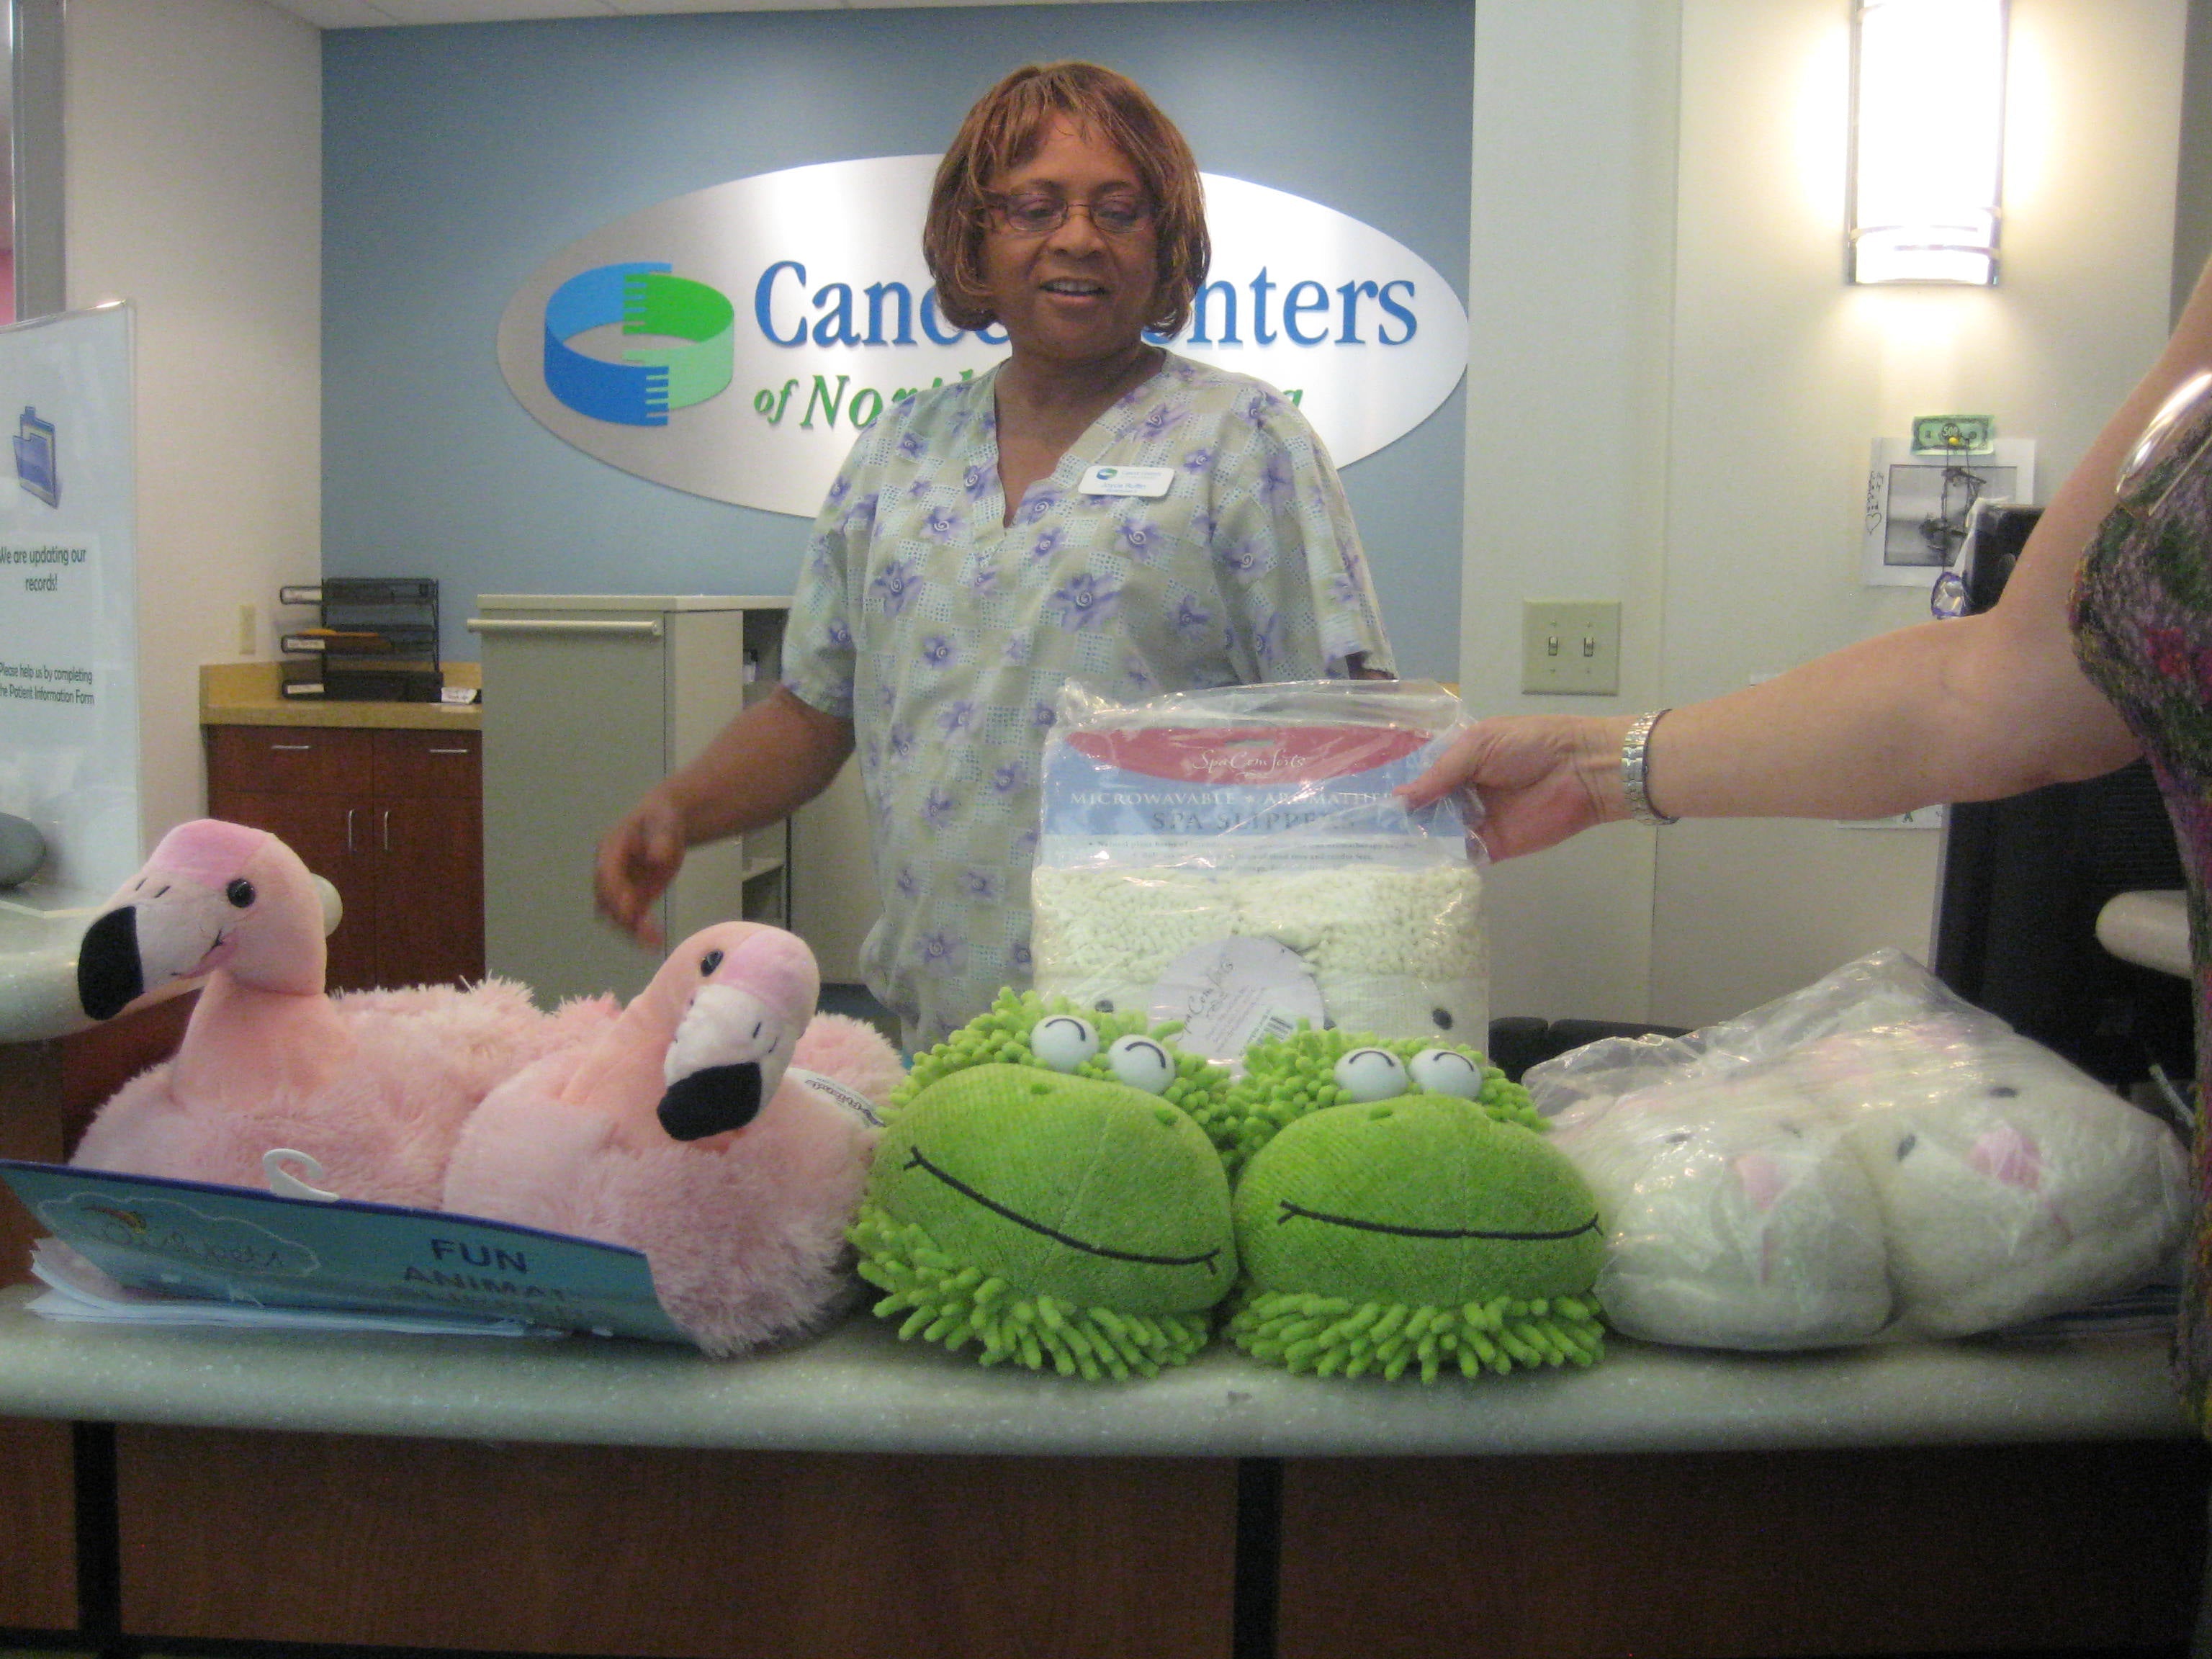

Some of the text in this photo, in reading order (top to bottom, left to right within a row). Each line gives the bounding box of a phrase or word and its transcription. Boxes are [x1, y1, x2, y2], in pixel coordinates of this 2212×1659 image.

[755, 260, 1010, 346] Canc
[753, 378, 799, 425] of
[14, 550, 27, 563] are
[30, 545, 68, 566] updating
[71, 548, 86, 562] our
[25, 573, 58, 591] records!
[19, 663, 34, 680] help
[35, 668, 42, 678] us
[44, 665, 53, 682] by
[54, 666, 92, 685] completing
[9, 683, 32, 699] Patient
[35, 685, 74, 703] Information
[76, 689, 95, 705] Form
[1070, 792, 1236, 806] MICROWAVABLE
[1154, 811, 1204, 830] SPA
[431, 1238, 529, 1274] FUN
